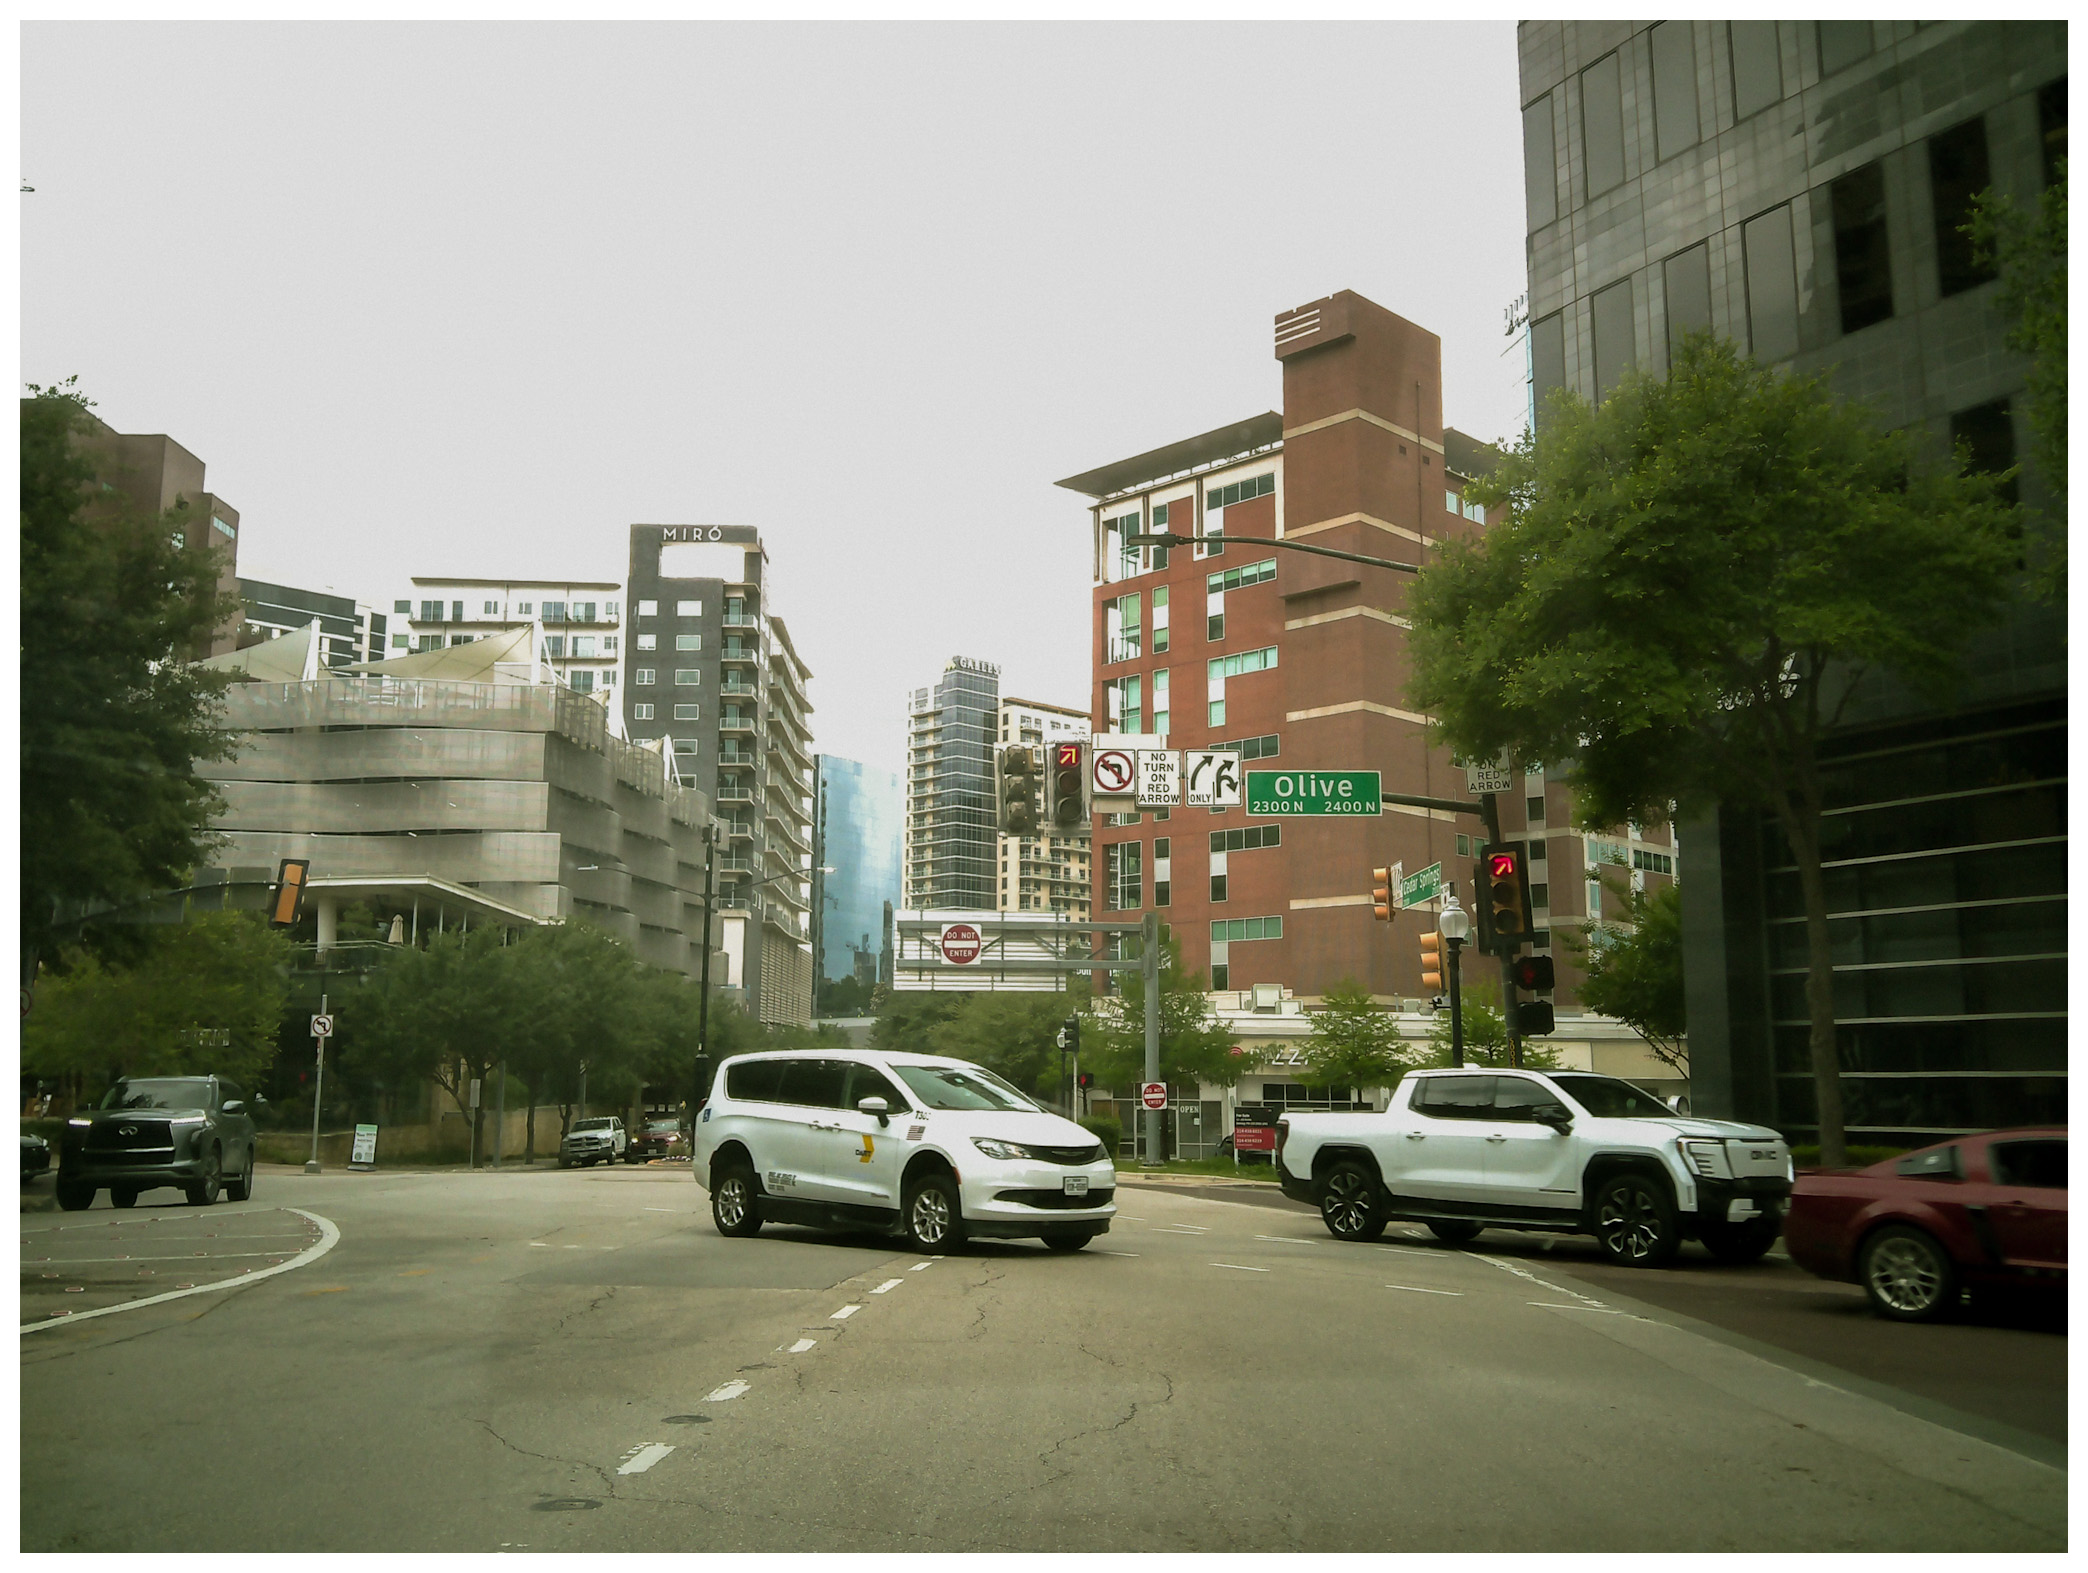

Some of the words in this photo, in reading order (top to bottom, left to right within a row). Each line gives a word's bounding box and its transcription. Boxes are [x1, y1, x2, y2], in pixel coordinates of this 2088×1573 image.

[1151, 753, 1166, 761] NO
[1144, 763, 1174, 772] TURN
[1151, 774, 1166, 782] ON
[1478, 771, 1500, 780] RED
[1147, 784, 1170, 793] RED
[1275, 774, 1353, 797] Olive
[1470, 780, 1510, 791] ARROW
[1140, 794, 1179, 803] ARROW
[1190, 794, 1211, 803] ONLY
[1253, 801, 1290, 812] 2300
[1294, 801, 1304, 812] N
[1325, 801, 1362, 812] 2400
[1366, 801, 1376, 812] N
[1403, 878, 1418, 896] Cedar
[1419, 868, 1440, 892] Springs
[1180, 1105, 1199, 1113] OPEN
